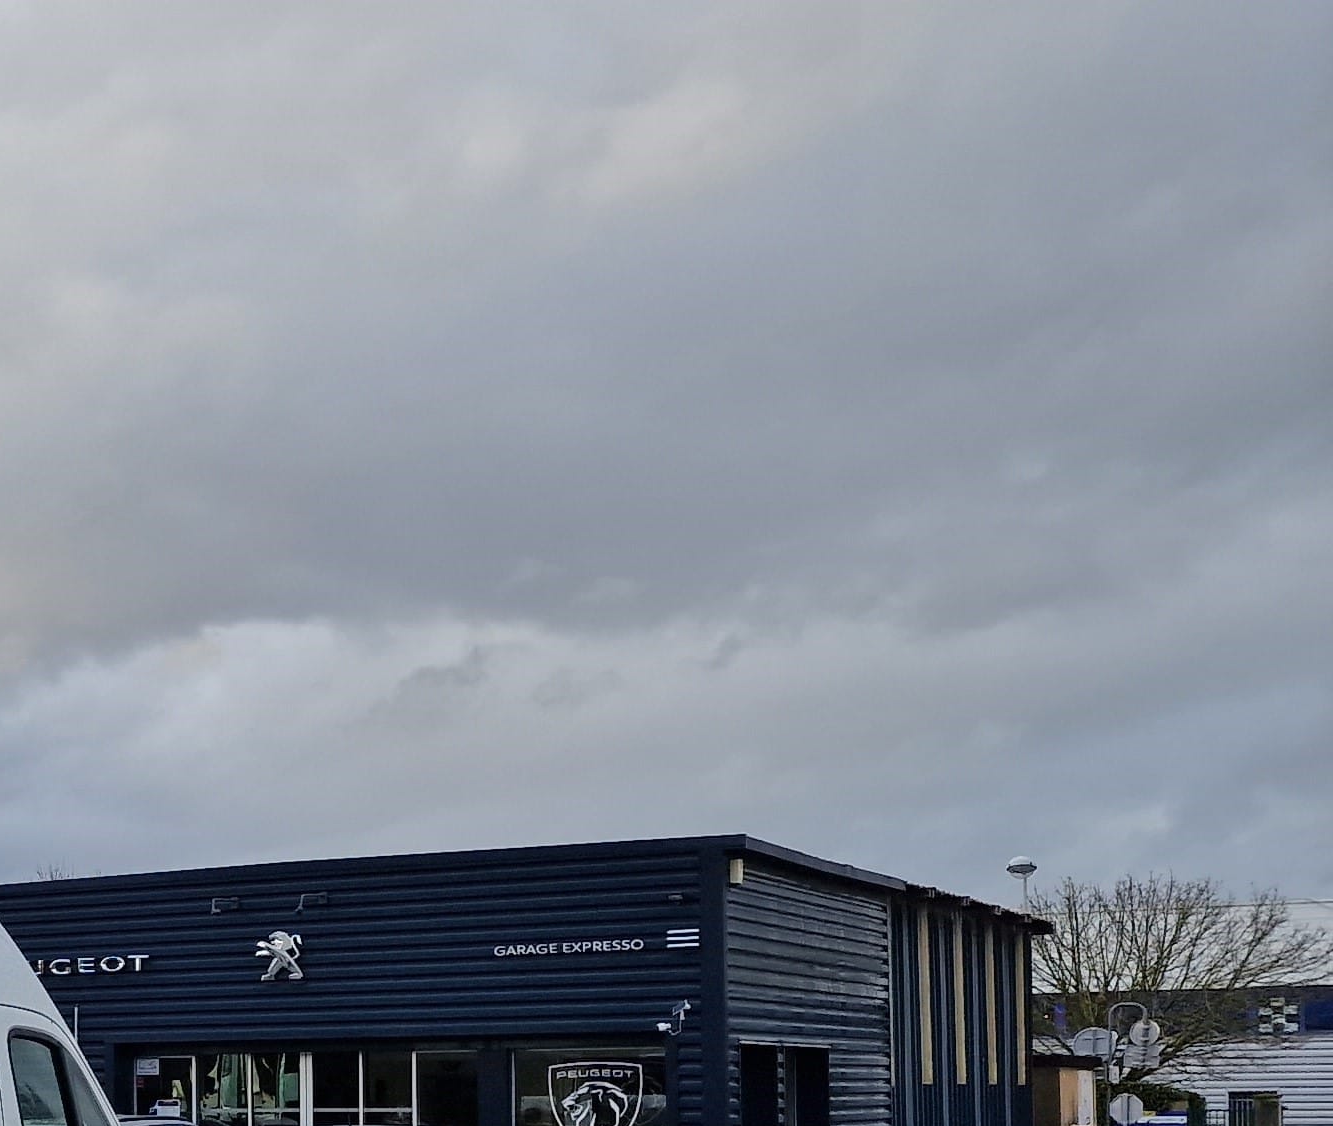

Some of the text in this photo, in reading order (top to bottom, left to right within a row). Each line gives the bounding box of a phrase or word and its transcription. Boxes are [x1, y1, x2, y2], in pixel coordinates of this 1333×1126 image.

[493, 939, 645, 957] GARAGE EXPRESSO
[556, 1069, 634, 1080] PEUGEOT
